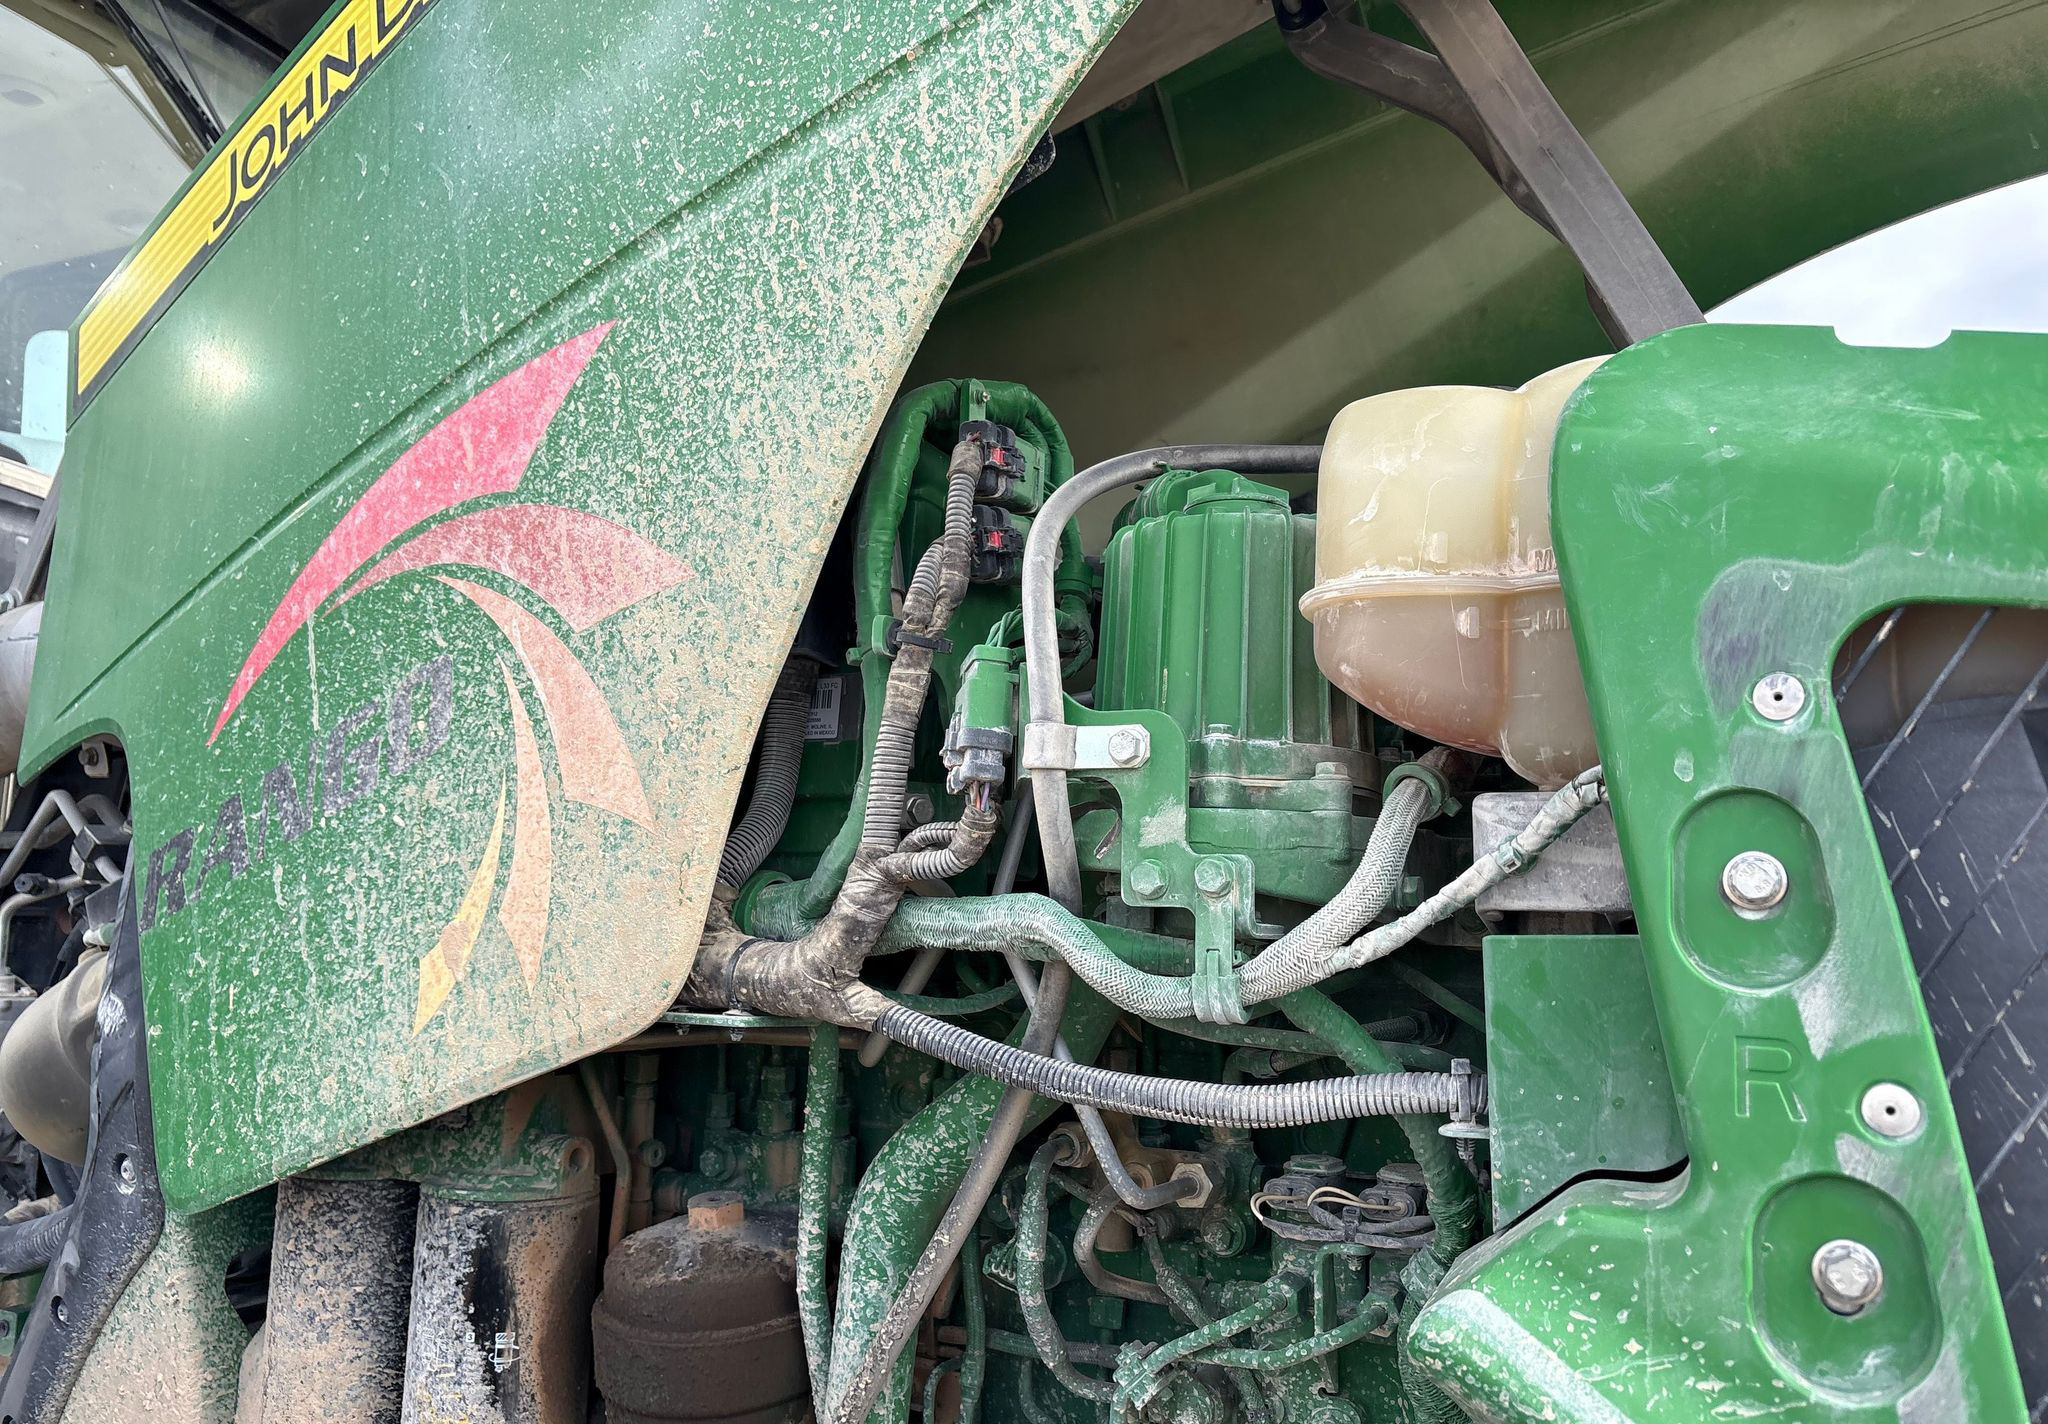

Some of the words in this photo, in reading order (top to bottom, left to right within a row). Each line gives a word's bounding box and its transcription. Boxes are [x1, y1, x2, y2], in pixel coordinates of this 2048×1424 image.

[213, 23, 357, 232] JOHN
[139, 654, 452, 935] RANGO
[1734, 1036, 1807, 1122] R
